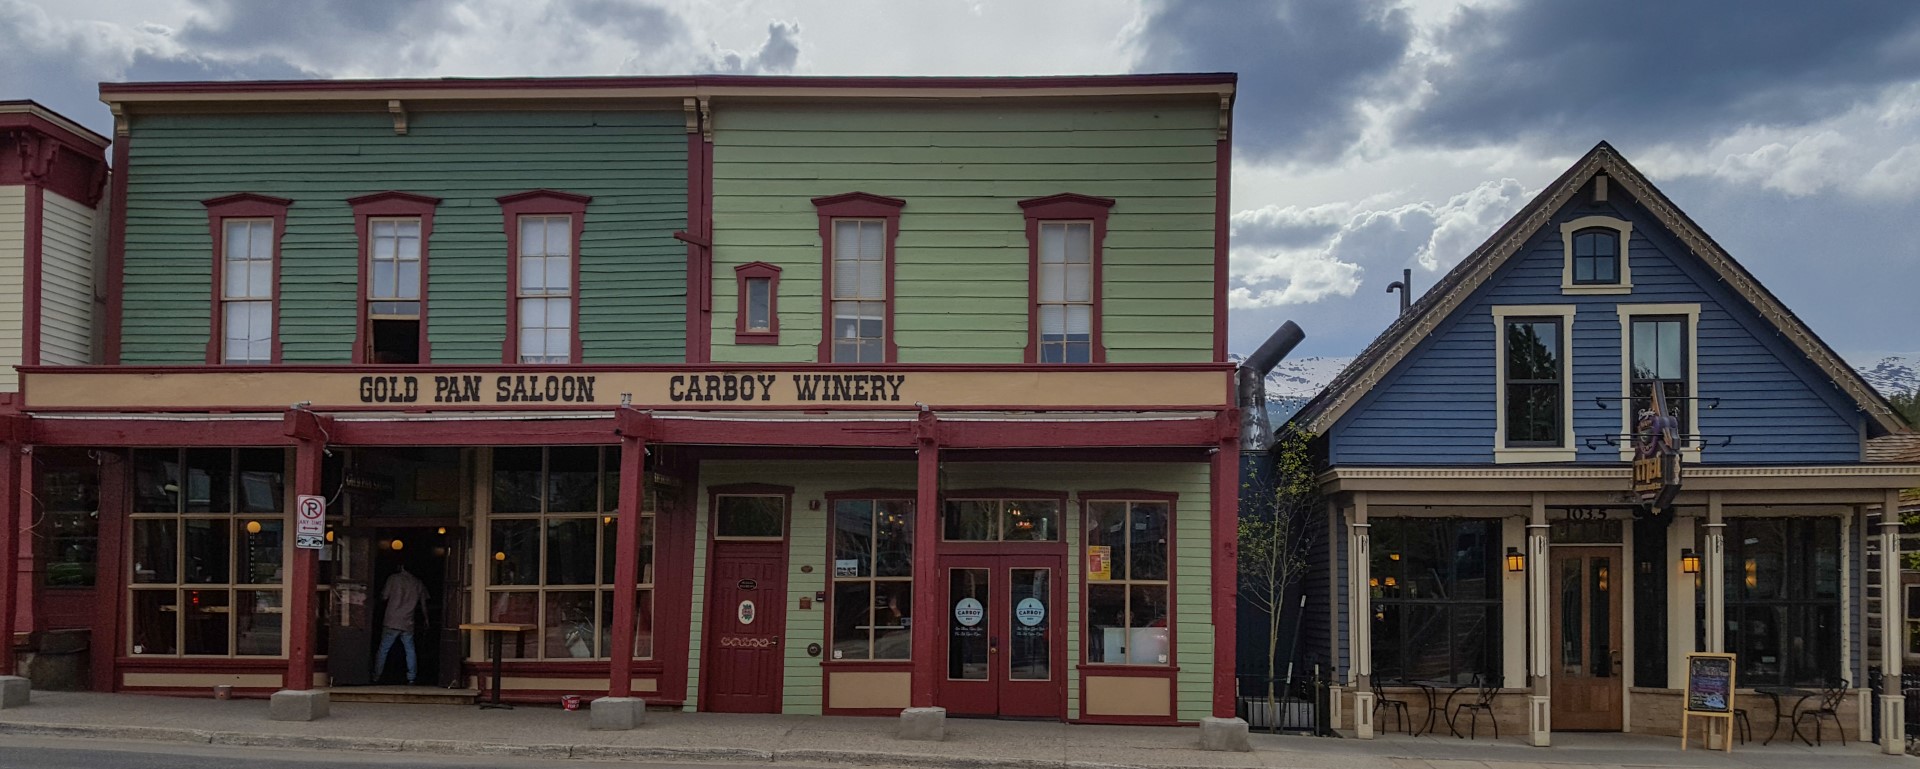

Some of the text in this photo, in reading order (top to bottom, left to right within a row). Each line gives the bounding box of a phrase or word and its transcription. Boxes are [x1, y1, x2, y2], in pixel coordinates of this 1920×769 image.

[360, 375, 595, 403] GOLD PAN SALOON
[670, 374, 905, 401] CARBOY WINERY
